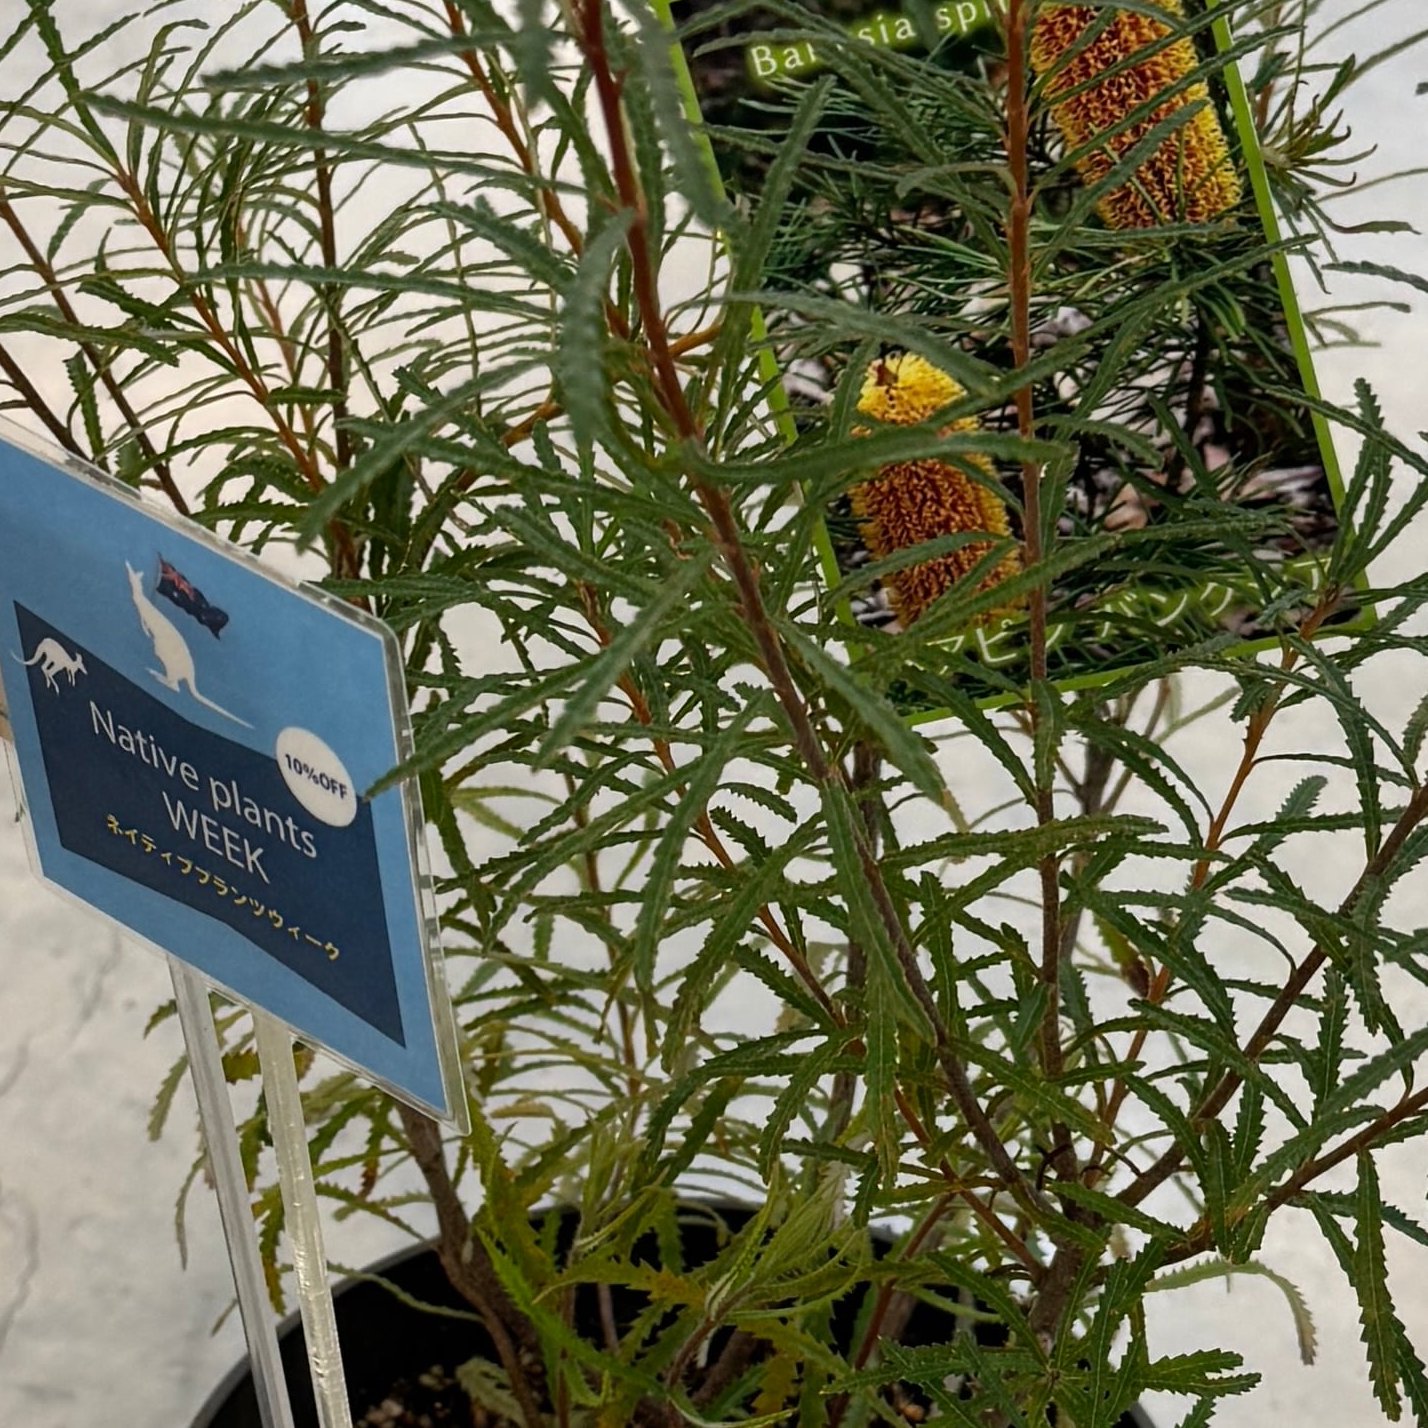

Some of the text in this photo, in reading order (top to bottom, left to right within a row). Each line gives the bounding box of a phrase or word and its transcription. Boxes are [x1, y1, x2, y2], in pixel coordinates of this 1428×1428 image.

[750, 12, 917, 78] Basia
[89, 699, 318, 859] Native plants
[284, 752, 348, 801] 10%OFF
[162, 790, 271, 885] WEEK
